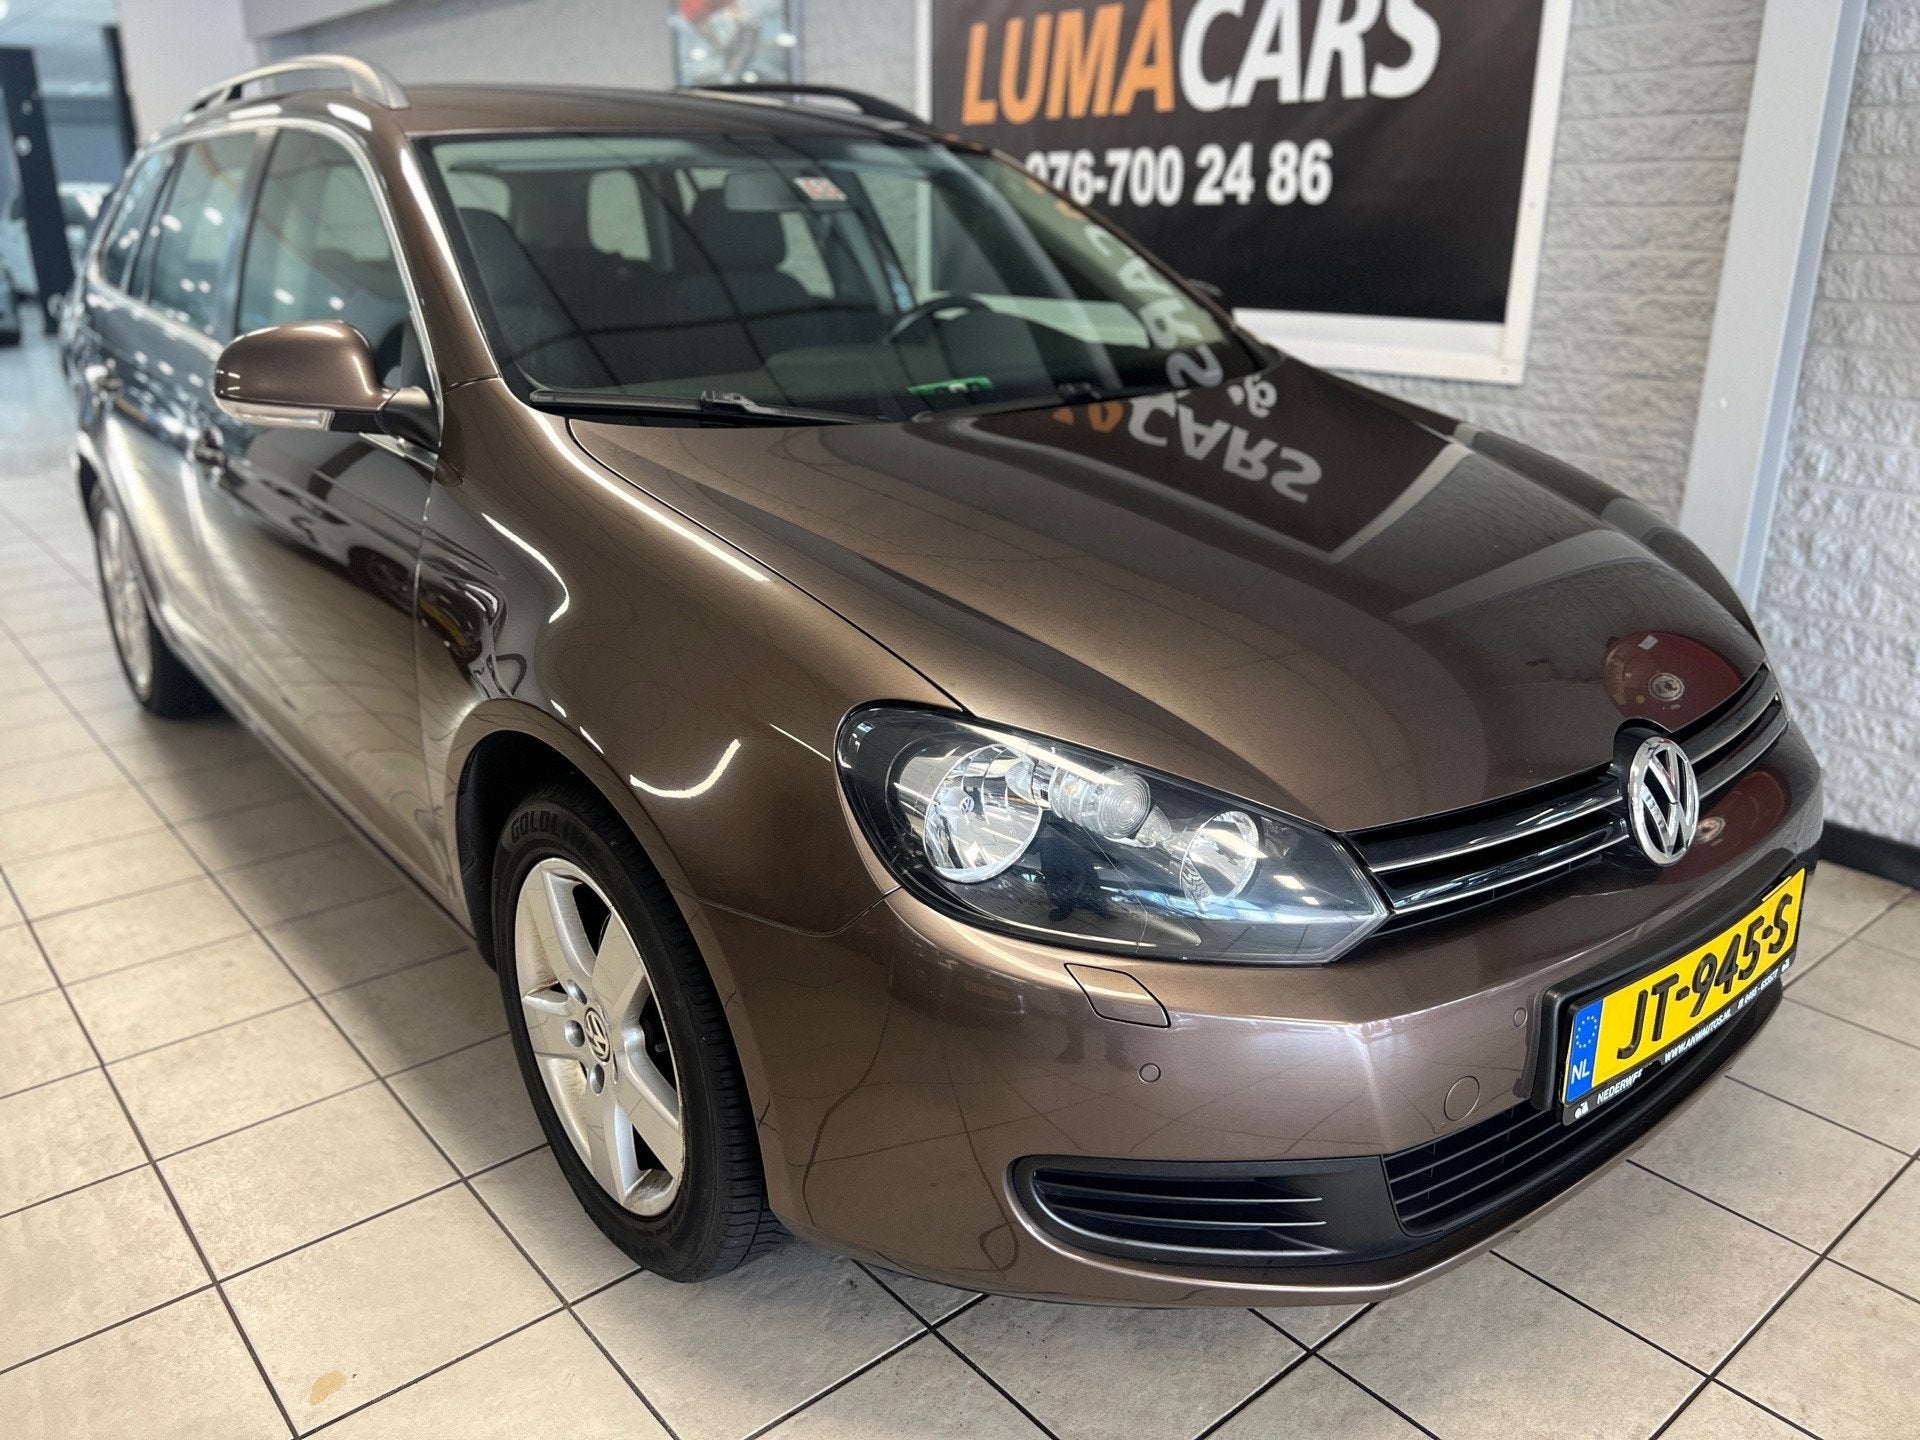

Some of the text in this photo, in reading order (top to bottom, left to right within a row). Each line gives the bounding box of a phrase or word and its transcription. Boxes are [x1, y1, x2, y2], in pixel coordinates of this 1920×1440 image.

[962, 0, 1440, 126] LUMACARS
[1194, 142, 1254, 205] 24
[1267, 139, 1333, 205] 86
[1616, 893, 1793, 1060] JT-945-S
[1570, 1058, 1591, 1085] NL
